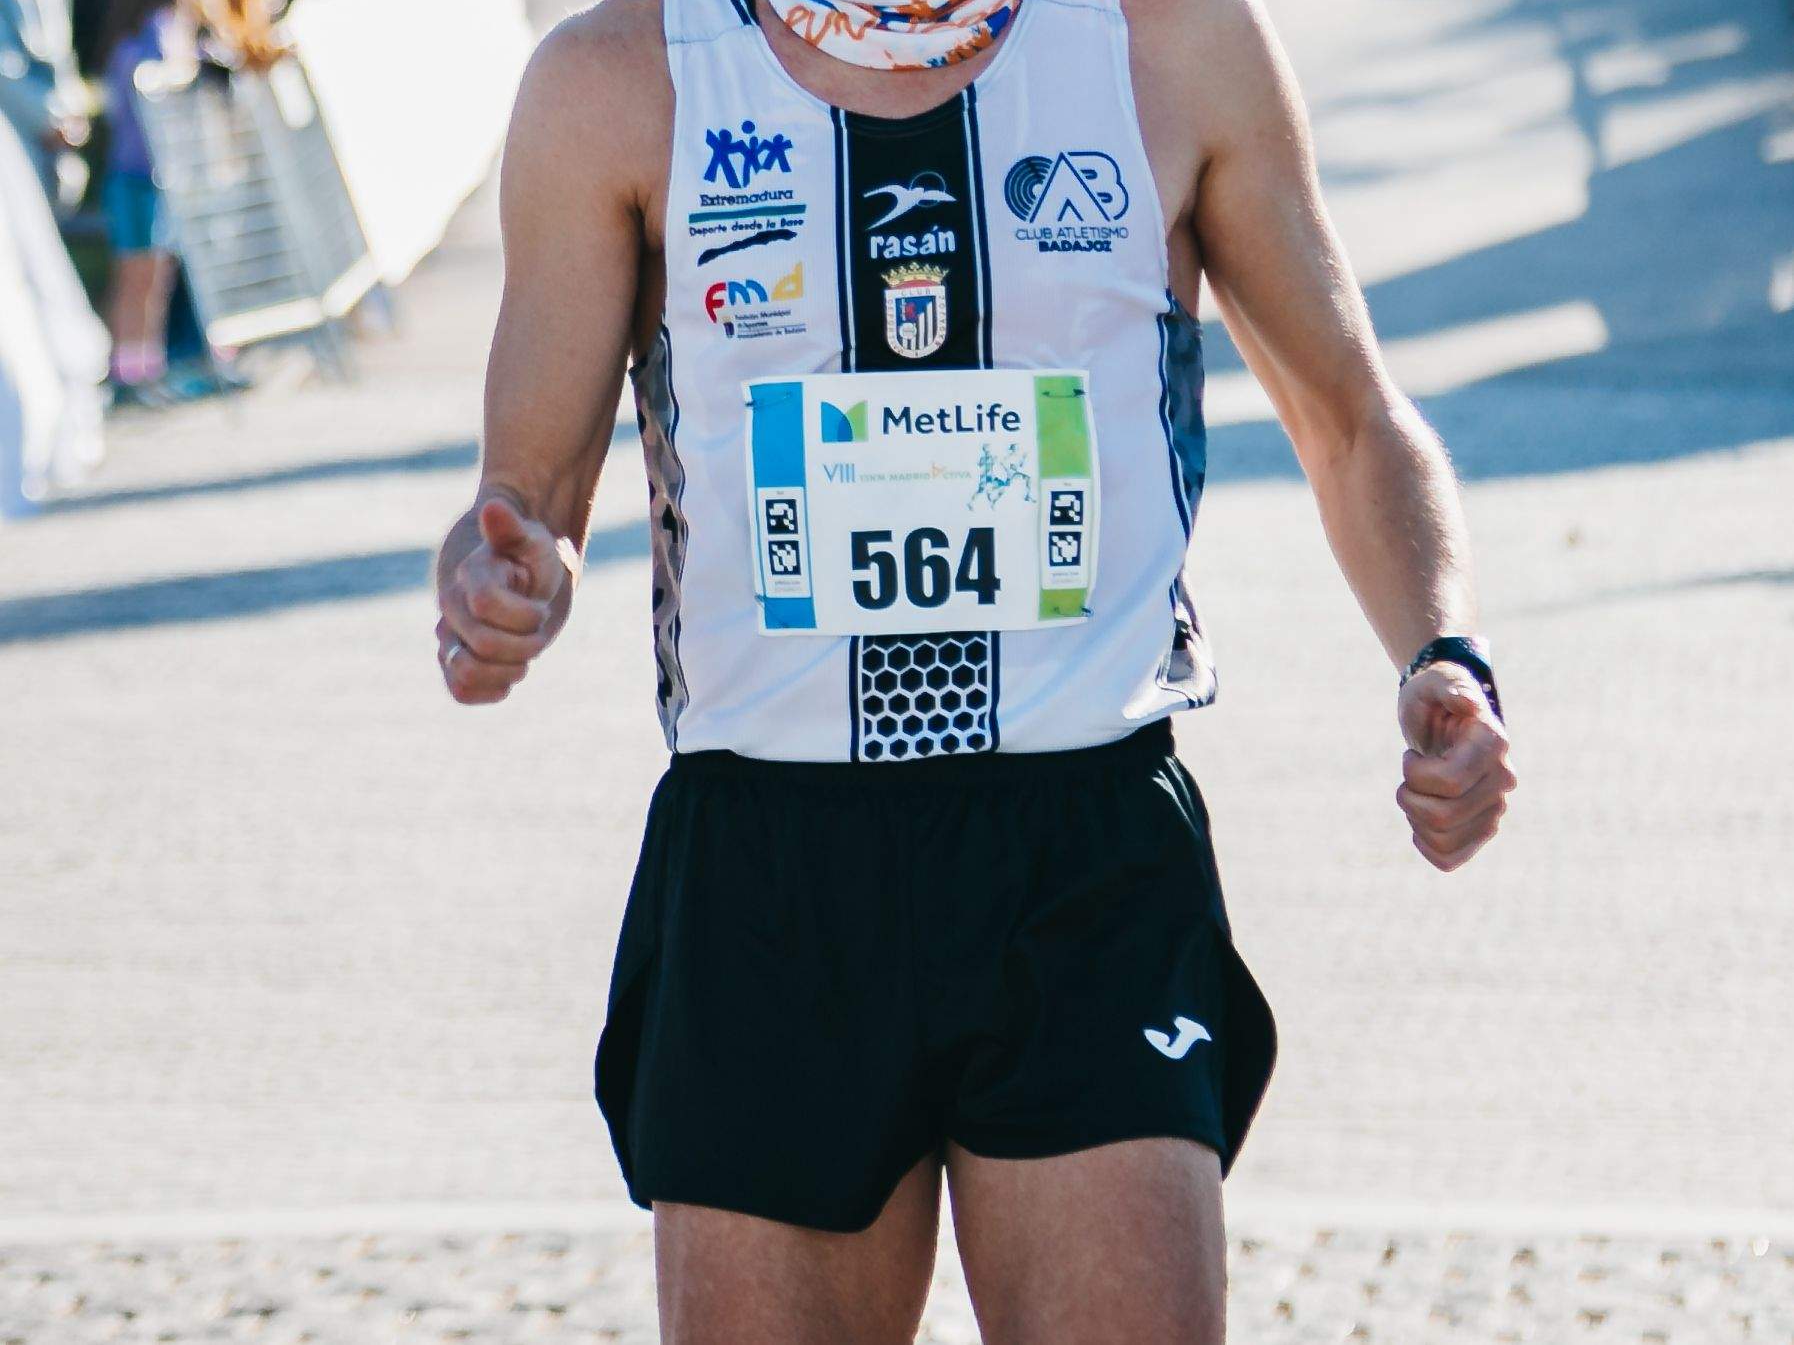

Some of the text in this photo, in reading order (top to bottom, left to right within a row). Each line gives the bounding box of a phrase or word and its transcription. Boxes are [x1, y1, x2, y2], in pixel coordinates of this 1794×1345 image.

[700, 190, 793, 206] Extremadura
[689, 218, 804, 237] Deporte desde la Base
[1015, 226, 1129, 240] CLUB ATLETISMO
[870, 225, 956, 259] rasán
[1039, 239, 1112, 252] BADAJOZ
[882, 404, 1021, 434] MetLife
[823, 463, 856, 483] VIII
[851, 527, 1001, 611] 564
